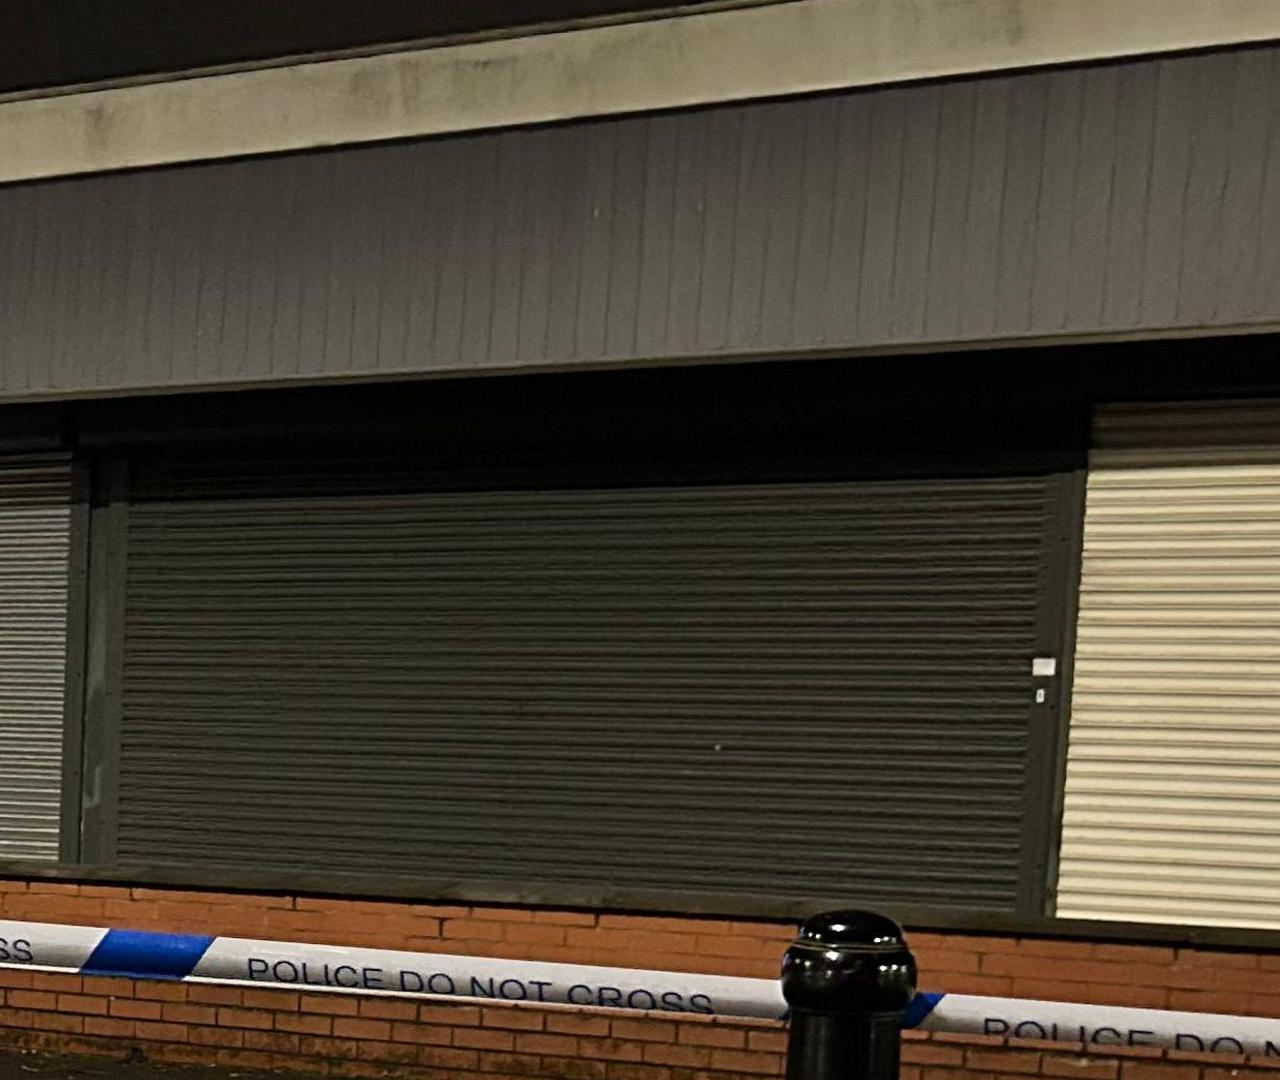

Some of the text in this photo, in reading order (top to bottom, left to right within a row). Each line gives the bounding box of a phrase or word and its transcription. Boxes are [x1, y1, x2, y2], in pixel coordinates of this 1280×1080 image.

[247, 957, 715, 1015] POLICE DO NOT CROSS
